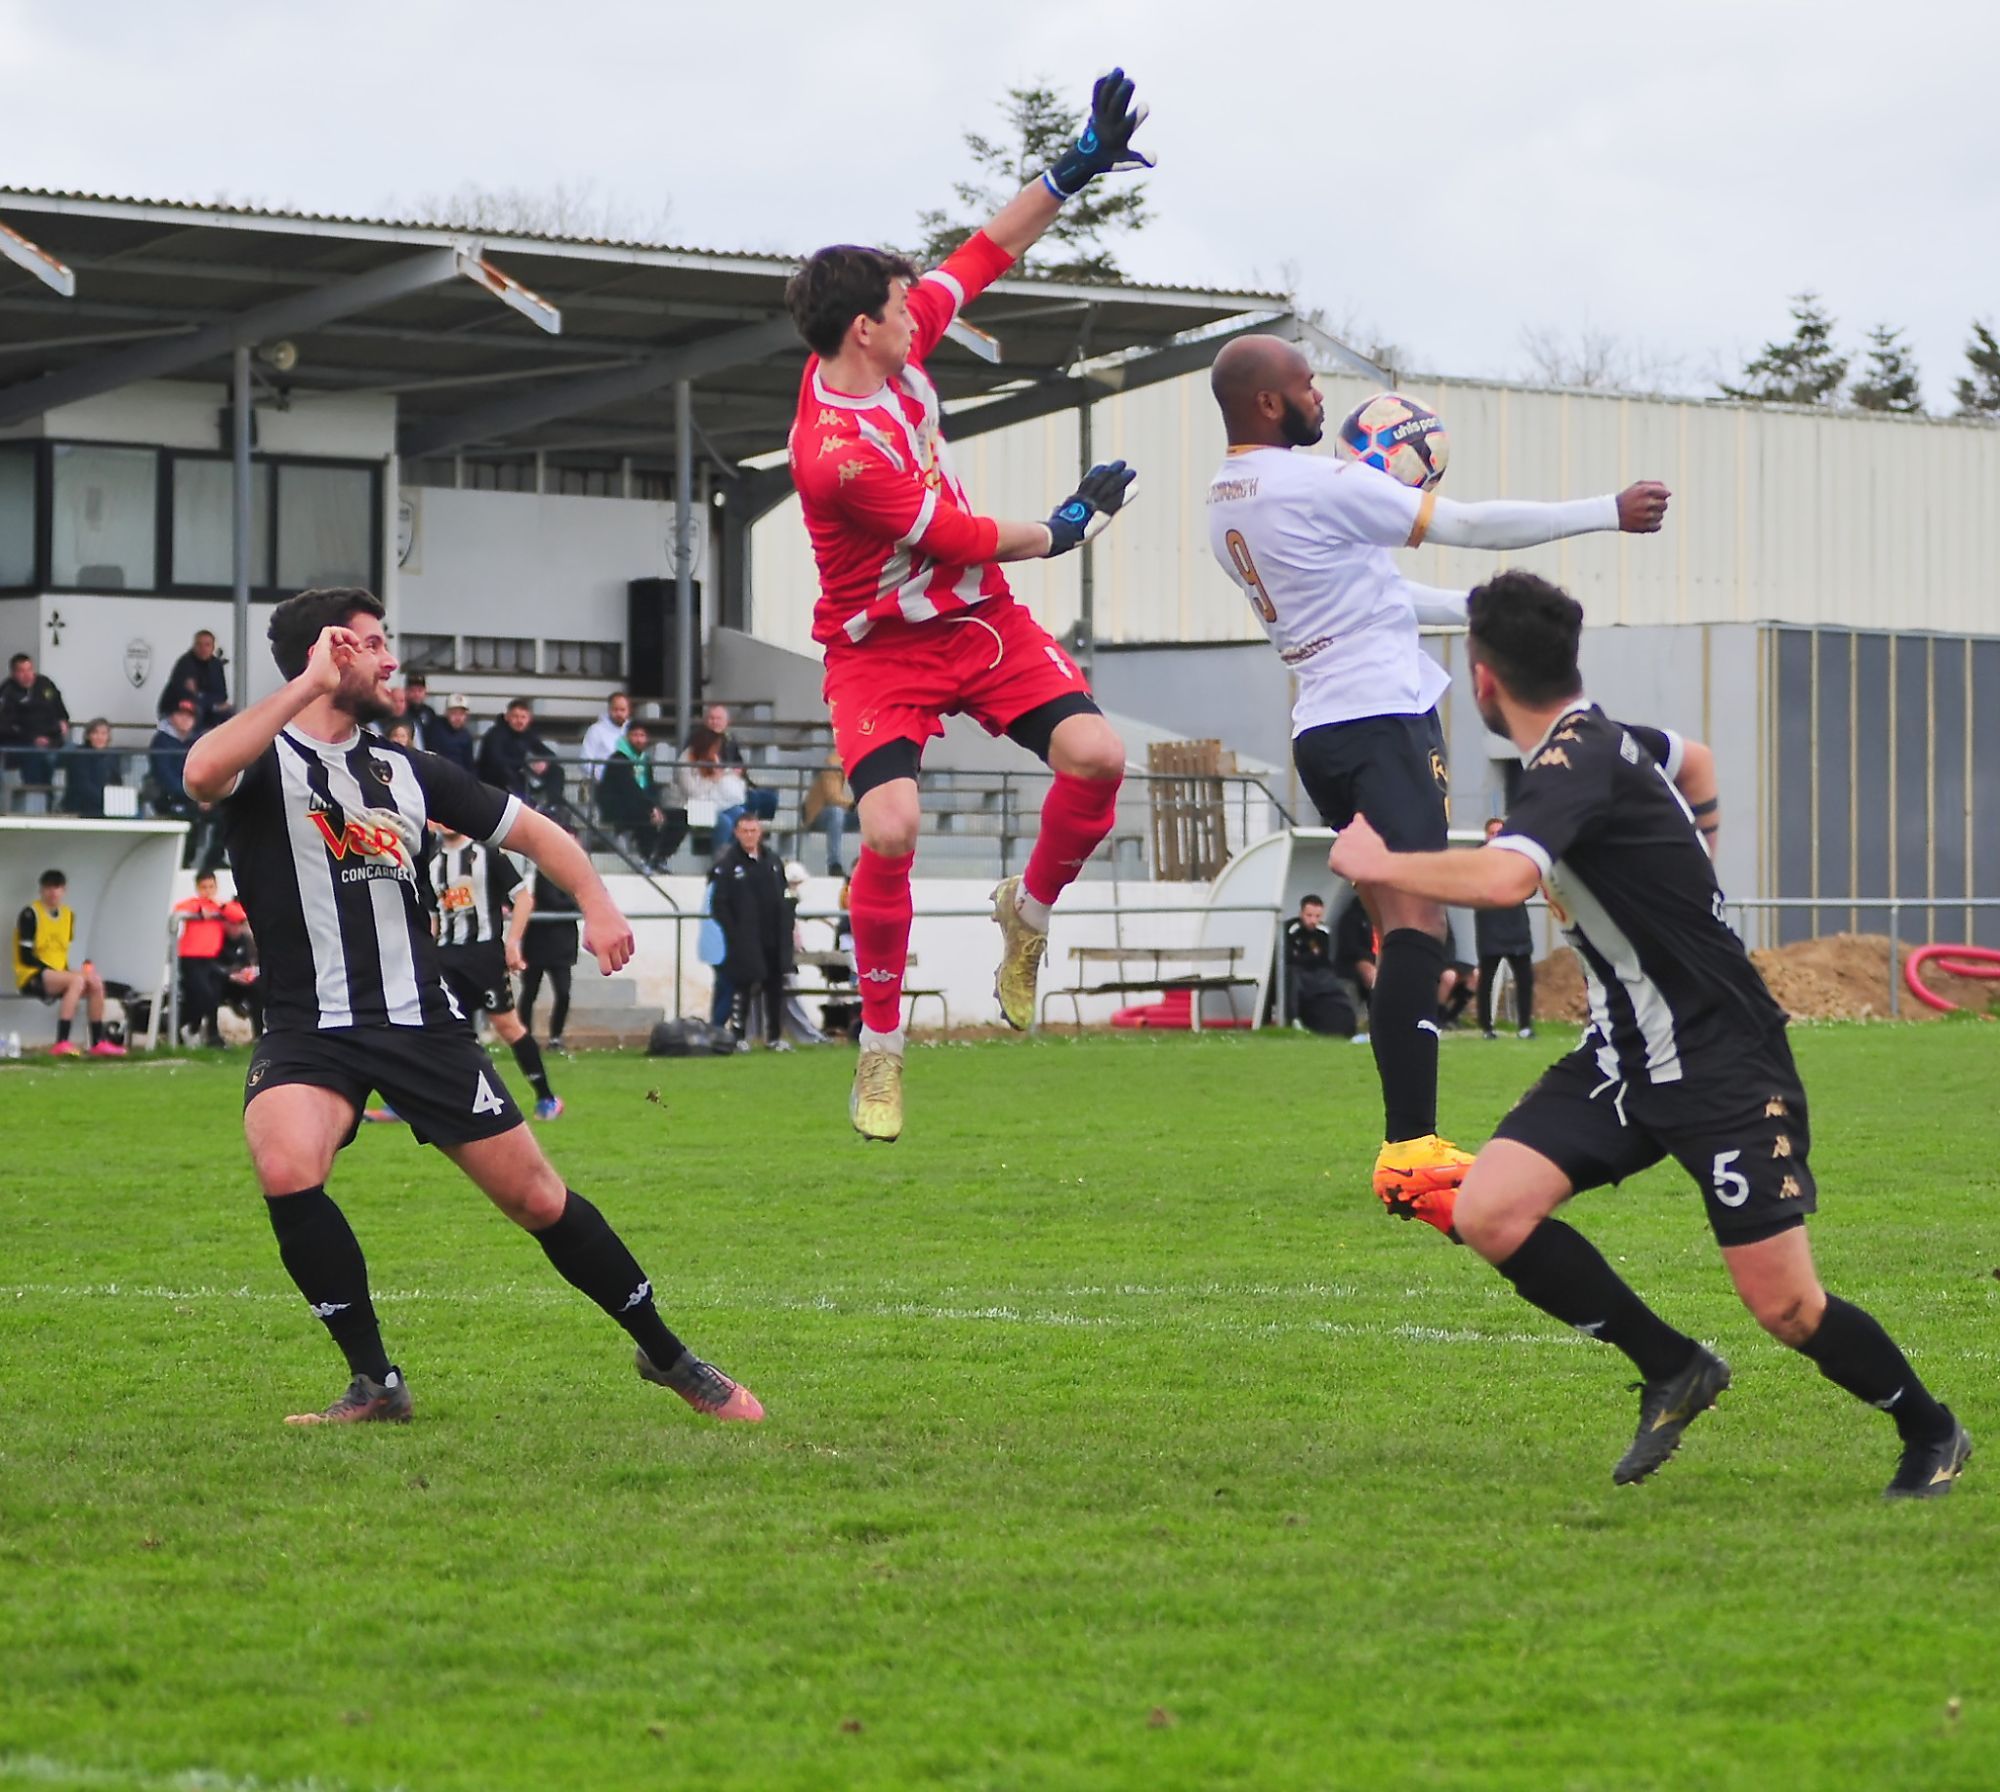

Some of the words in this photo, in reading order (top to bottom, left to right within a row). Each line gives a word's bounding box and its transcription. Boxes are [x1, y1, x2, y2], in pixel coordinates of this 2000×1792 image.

[1226, 529, 1277, 623] 9
[341, 864, 413, 883] CONCARNE
[485, 990, 497, 1009] 3
[472, 1069, 504, 1116] 4
[1713, 1149, 1749, 1207] 5
